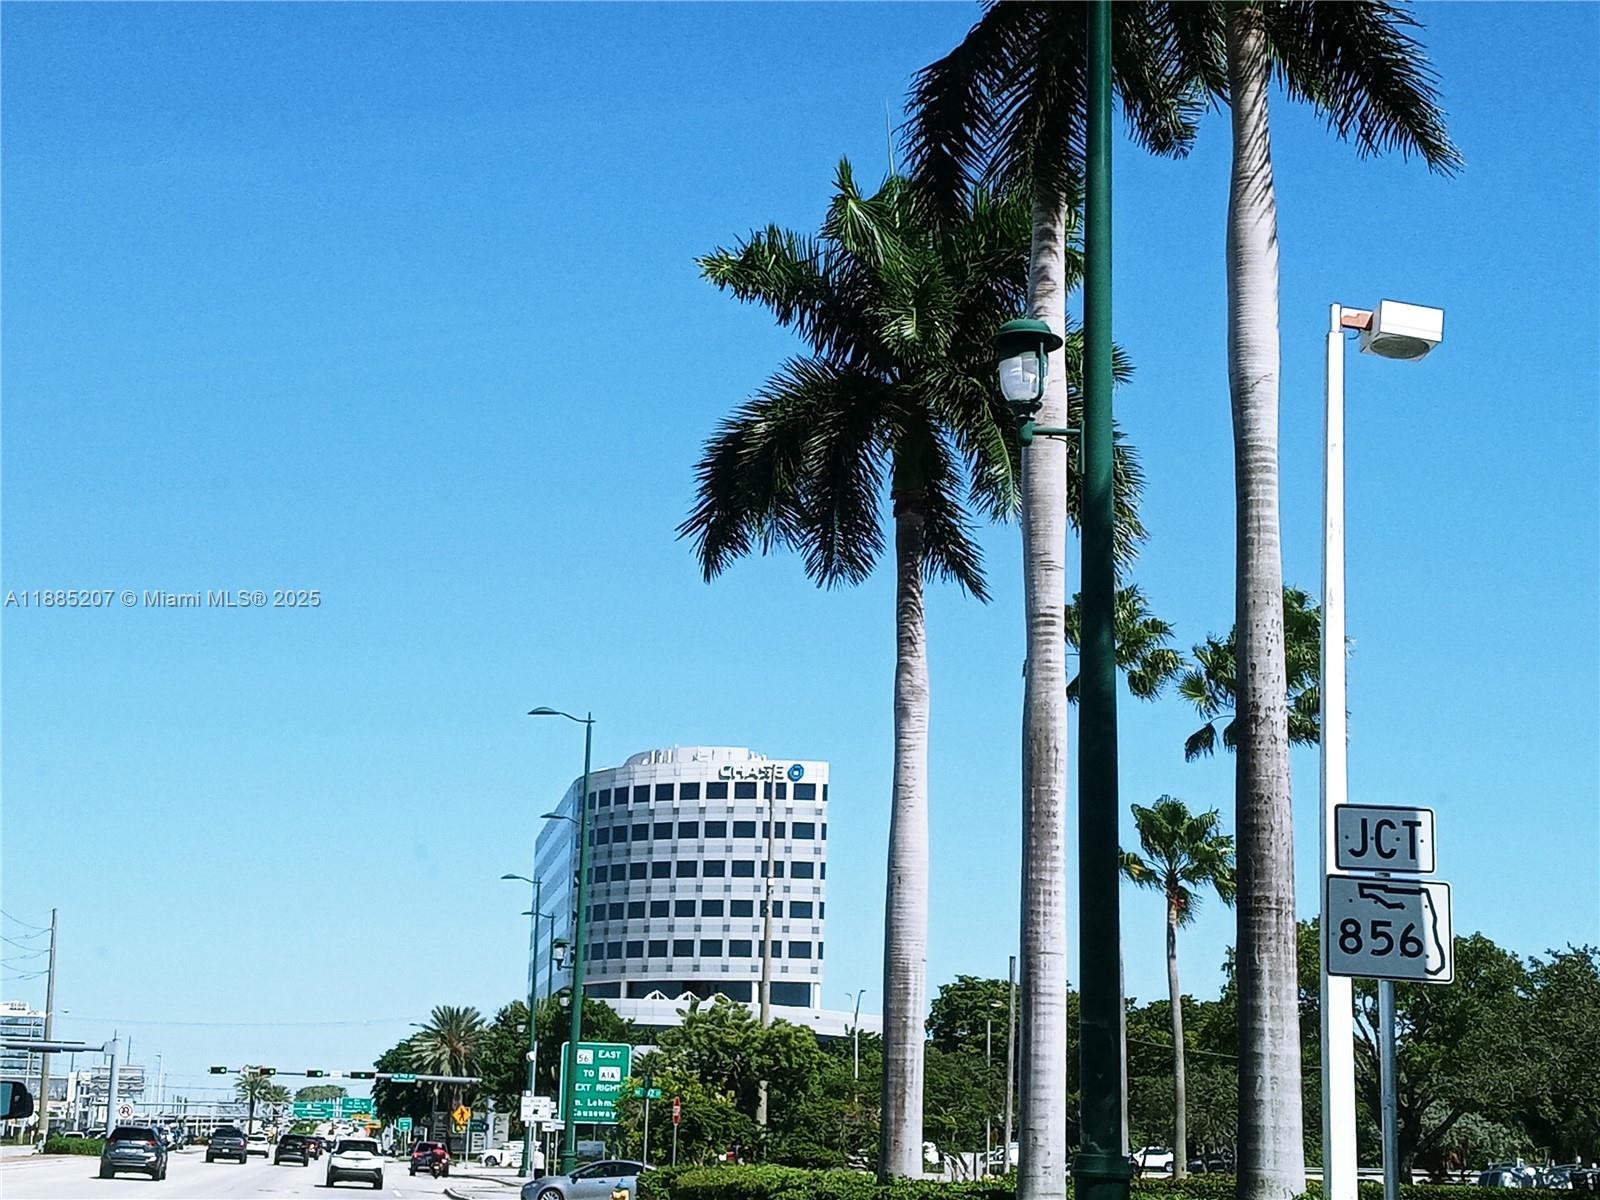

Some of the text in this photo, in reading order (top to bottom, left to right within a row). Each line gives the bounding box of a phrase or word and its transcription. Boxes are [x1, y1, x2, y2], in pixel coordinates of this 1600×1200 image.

[718, 764, 785, 780] CHASE
[1348, 817, 1422, 860] JCT
[1339, 918, 1424, 958] 856
[577, 1050, 621, 1063] 56 EAST
[583, 1069, 616, 1079] TO A1A
[575, 1083, 621, 1092] EXT RIGHT
[587, 1098, 617, 1107] Lehm
